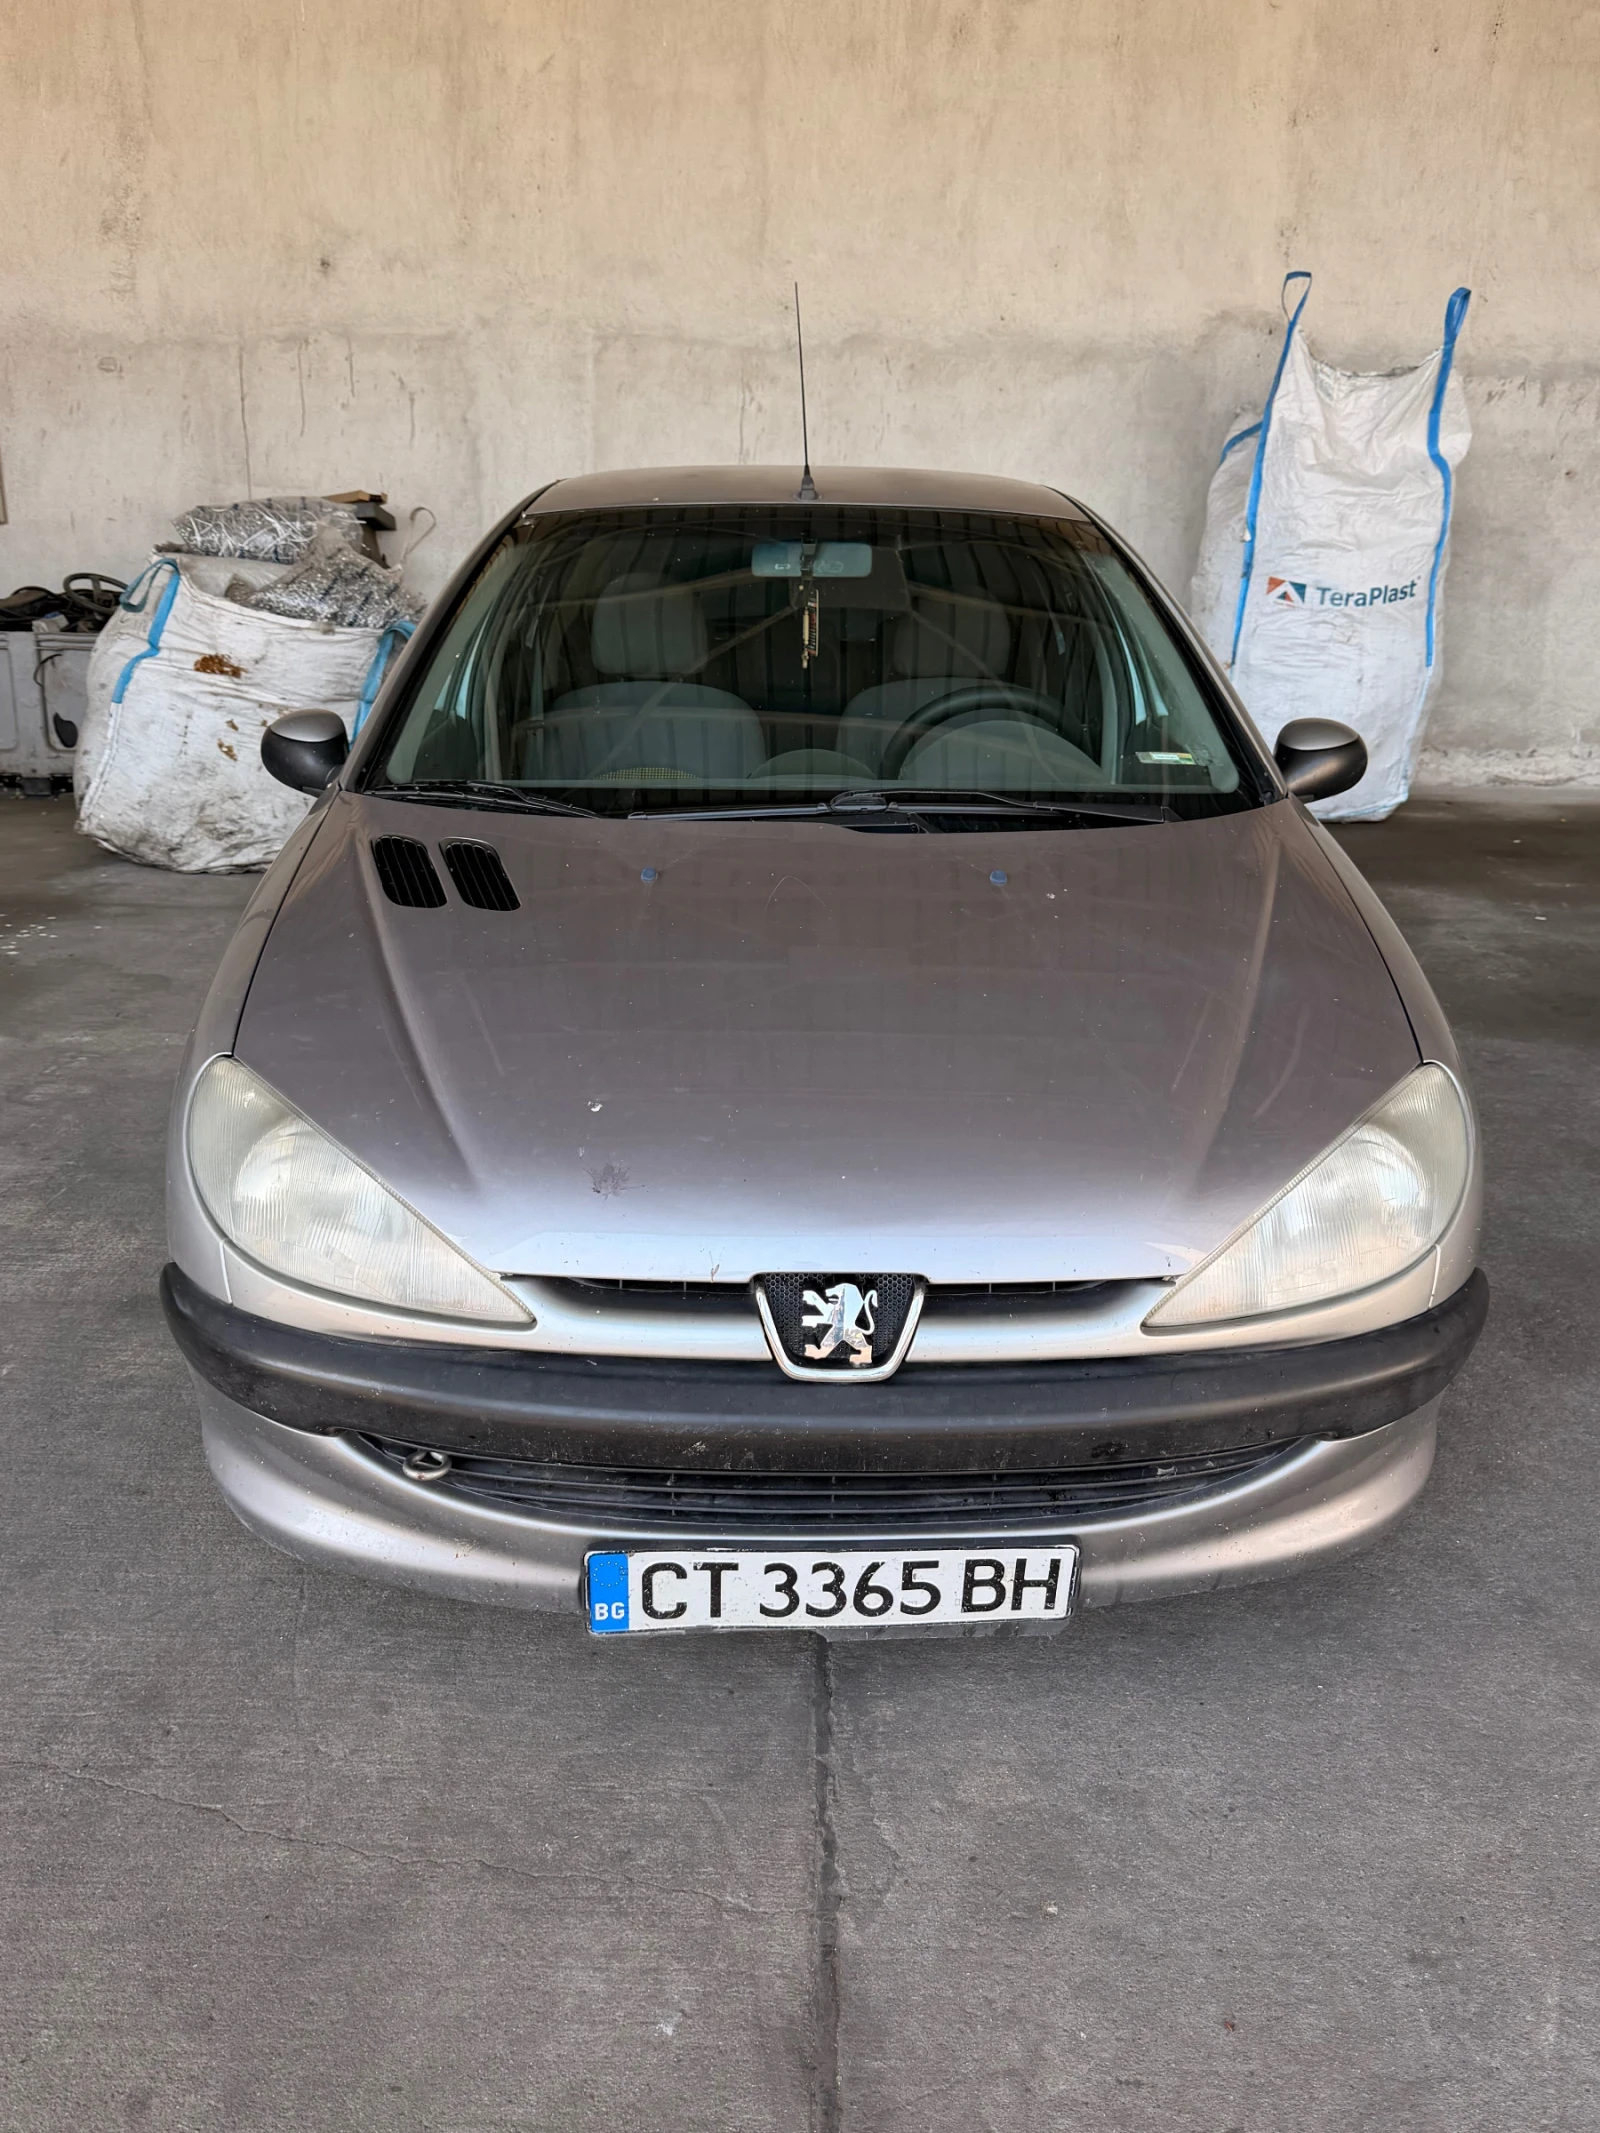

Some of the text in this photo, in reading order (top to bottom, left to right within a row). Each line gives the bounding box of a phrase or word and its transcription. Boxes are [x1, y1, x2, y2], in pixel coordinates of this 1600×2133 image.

[1316, 579, 1418, 607] TeraPlast
[641, 1557, 1062, 1620] CT 3365 BH
[594, 1603, 625, 1621] BG
